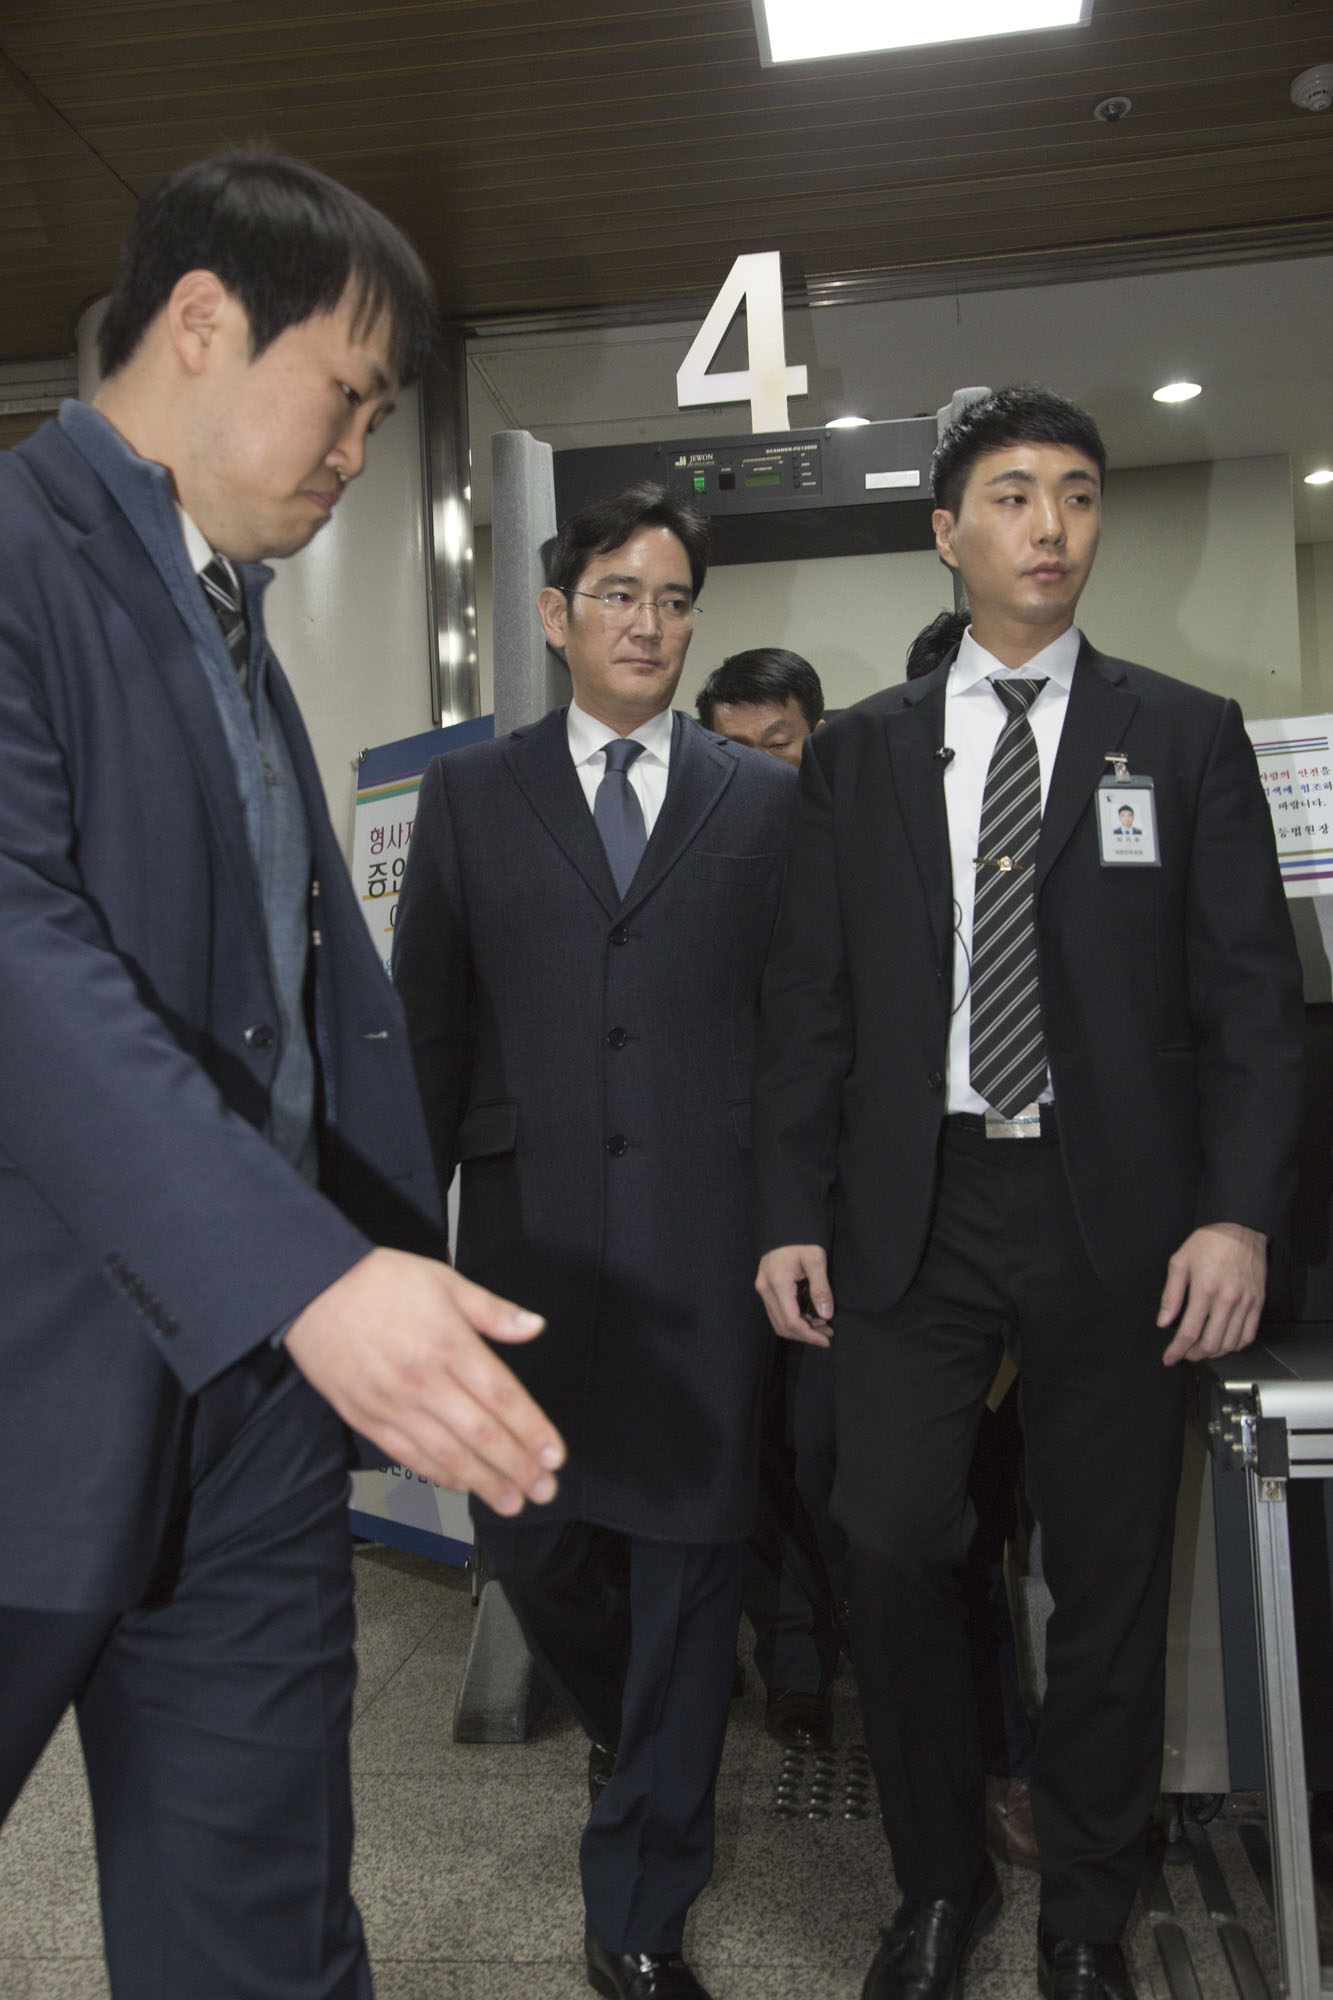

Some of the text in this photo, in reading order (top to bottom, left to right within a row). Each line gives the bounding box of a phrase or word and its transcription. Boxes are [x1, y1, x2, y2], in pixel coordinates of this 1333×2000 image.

[676, 251, 808, 434] 4
[690, 453, 714, 463] JEWON
[1278, 798, 1327, 811] 바랍니다.
